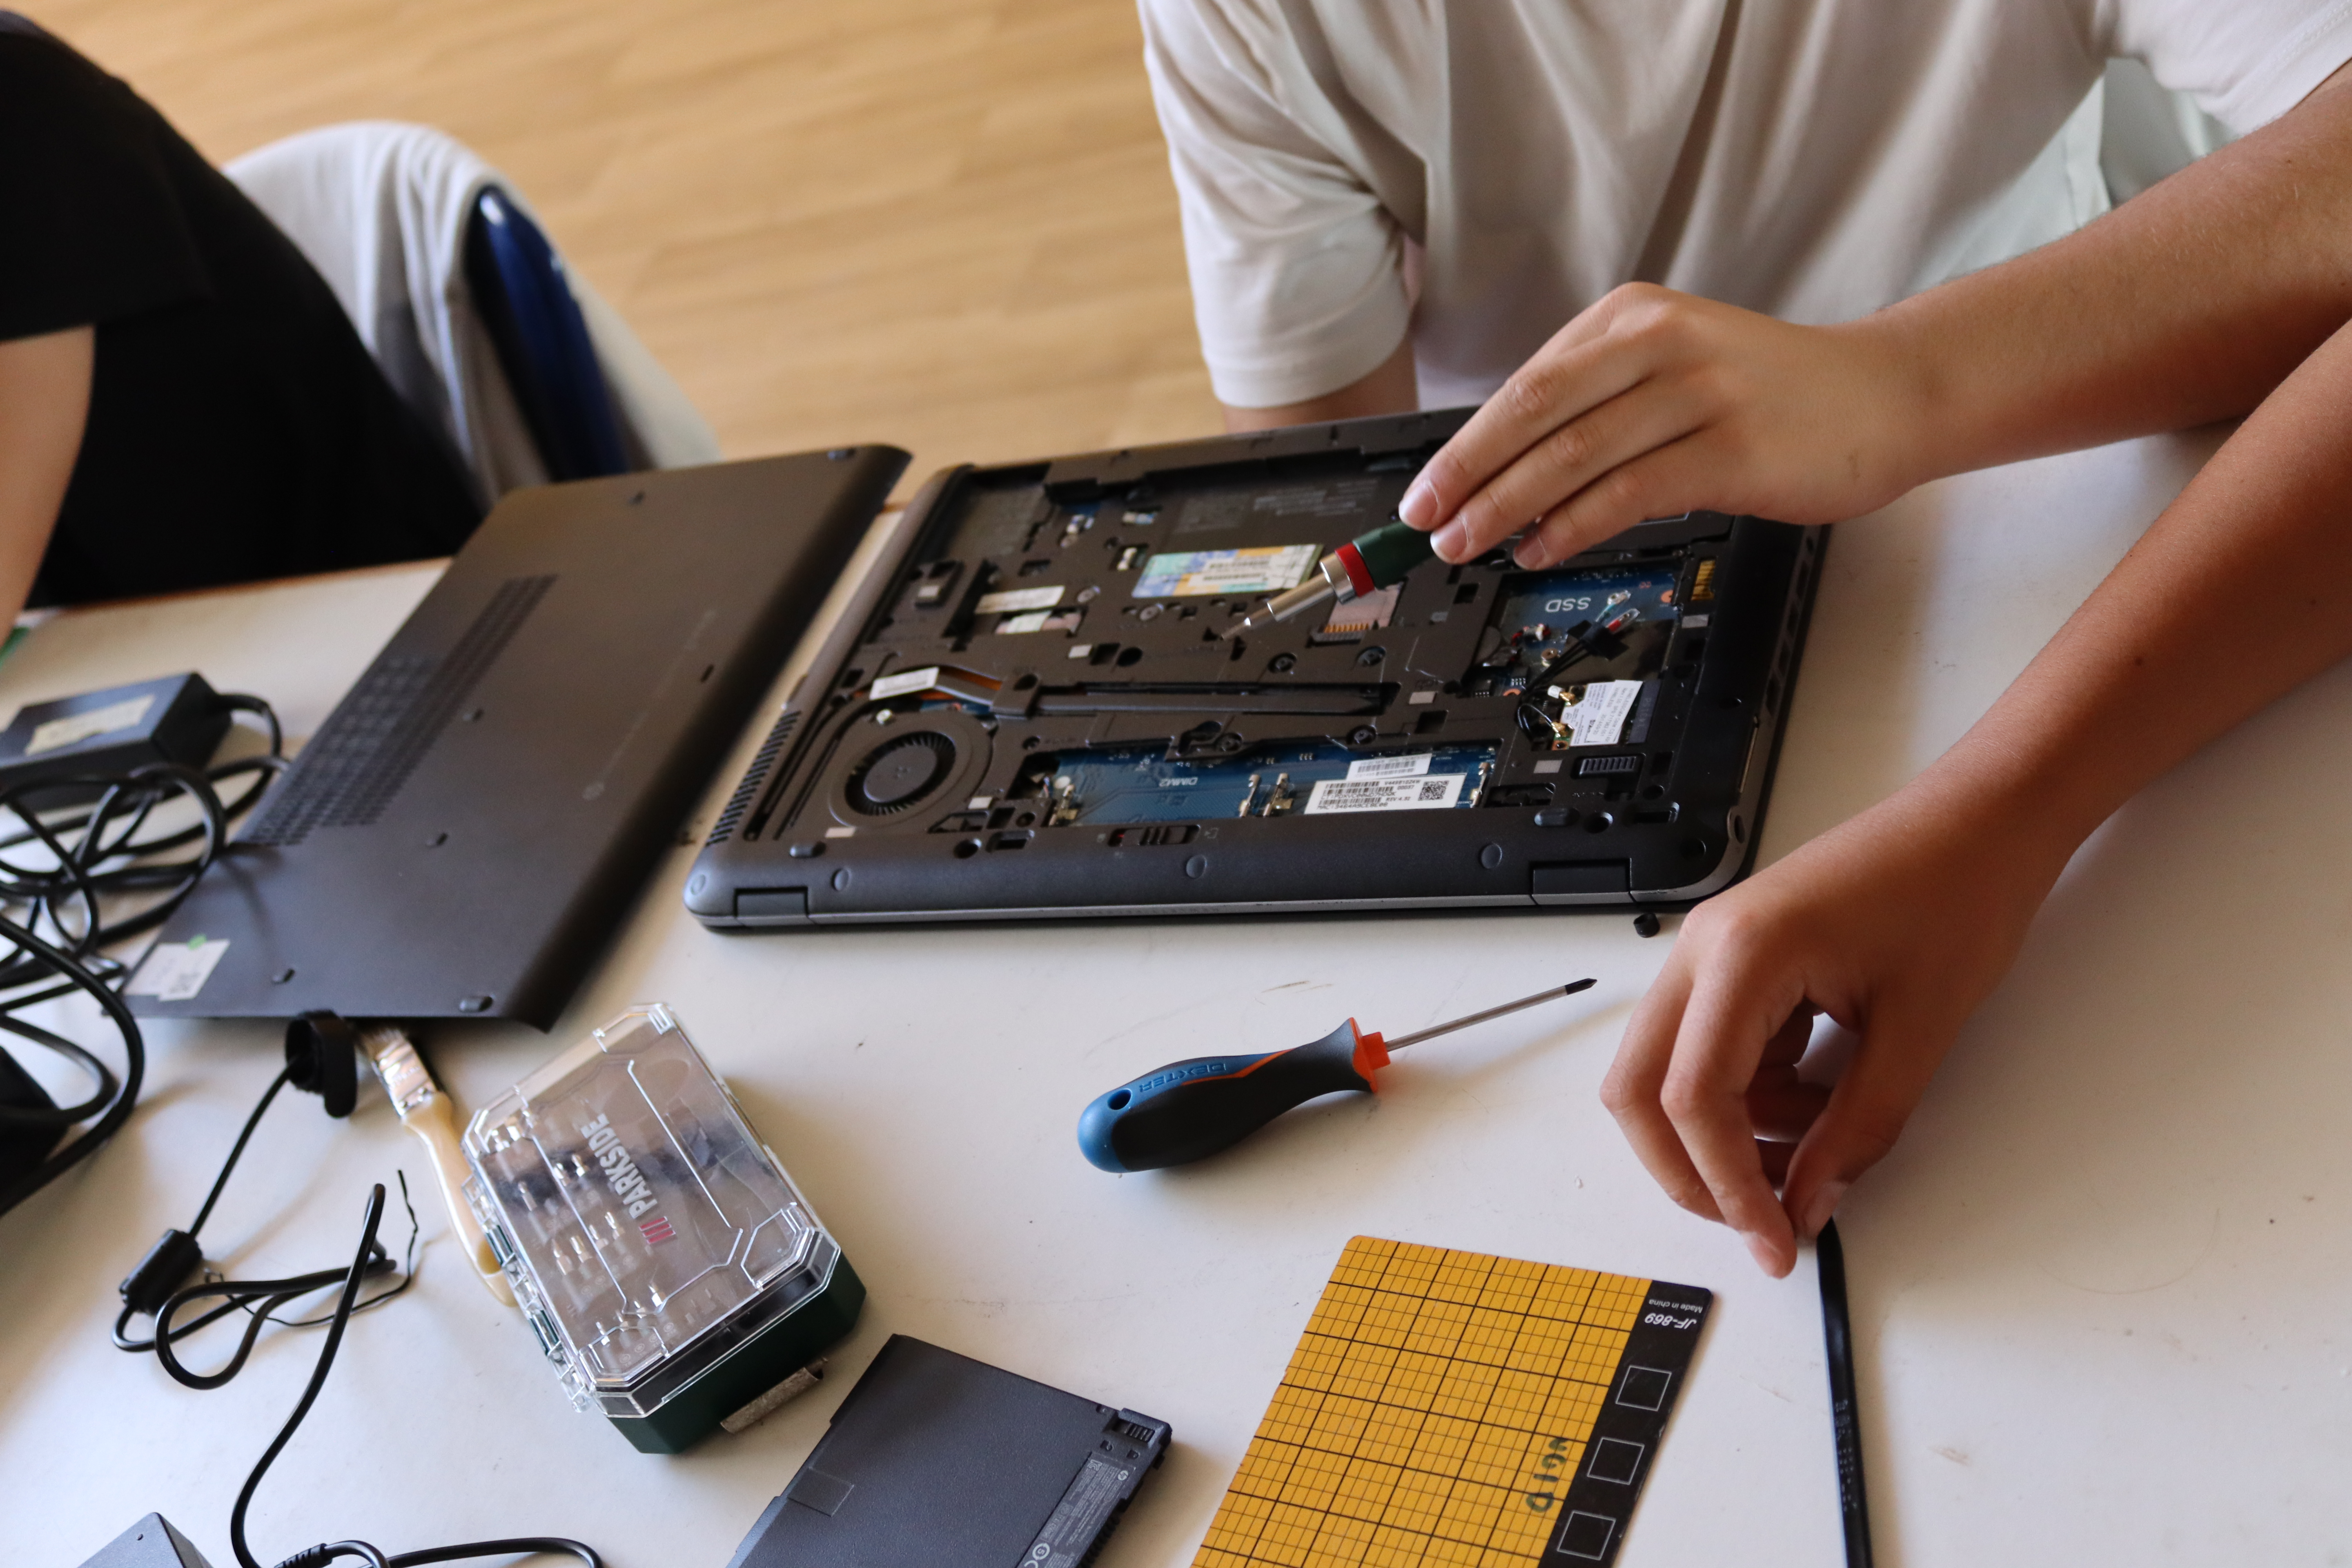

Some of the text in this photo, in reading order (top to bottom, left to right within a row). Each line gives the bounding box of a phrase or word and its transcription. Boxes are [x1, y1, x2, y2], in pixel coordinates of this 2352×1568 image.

[1545, 597, 1592, 613] SSD
[1158, 777, 1198, 787] DIMM2
[1139, 1063, 1227, 1093] DEXTER
[580, 1112, 658, 1220] PARKSIDE
[1648, 1299, 1671, 1308] china
[1680, 1303, 1703, 1314] Made
[1644, 1312, 1697, 1329] JF-869
